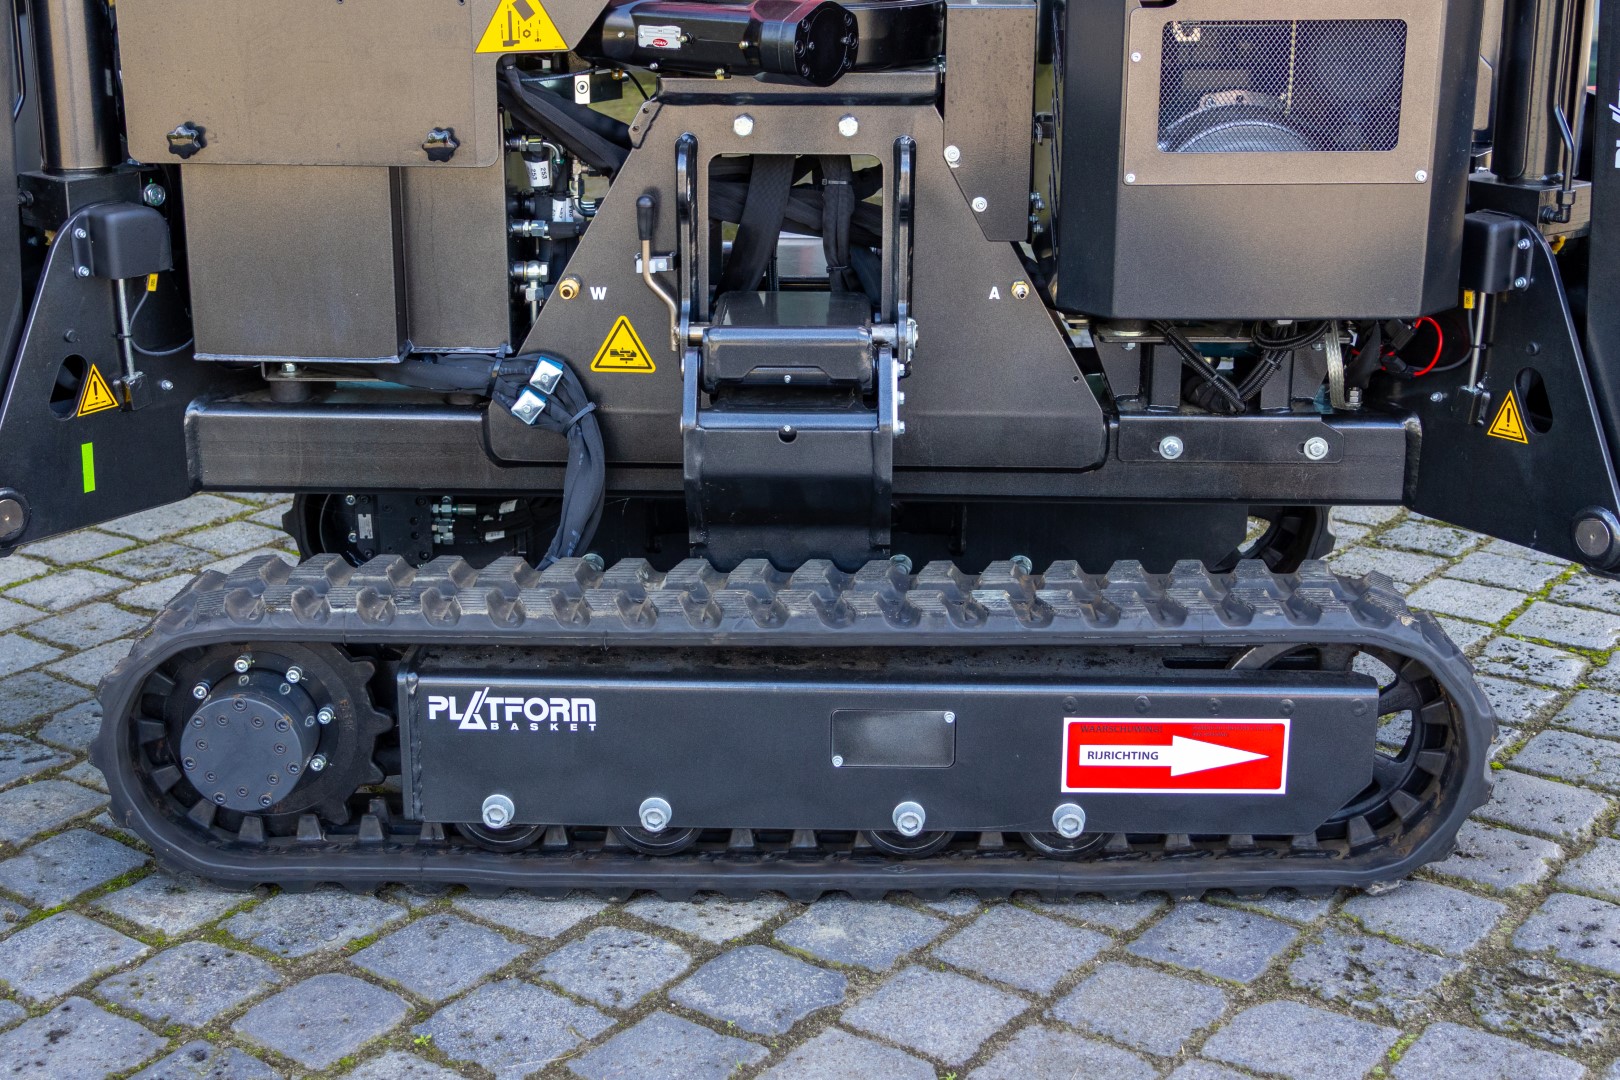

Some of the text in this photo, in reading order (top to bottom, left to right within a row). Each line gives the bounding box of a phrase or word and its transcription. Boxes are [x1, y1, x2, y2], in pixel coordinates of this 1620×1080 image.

[590, 286, 607, 300] W
[988, 286, 1001, 300] A
[428, 687, 597, 730] PLATFORM
[490, 722, 597, 732] BASKET
[1087, 751, 1159, 761] RIJRICHTING
